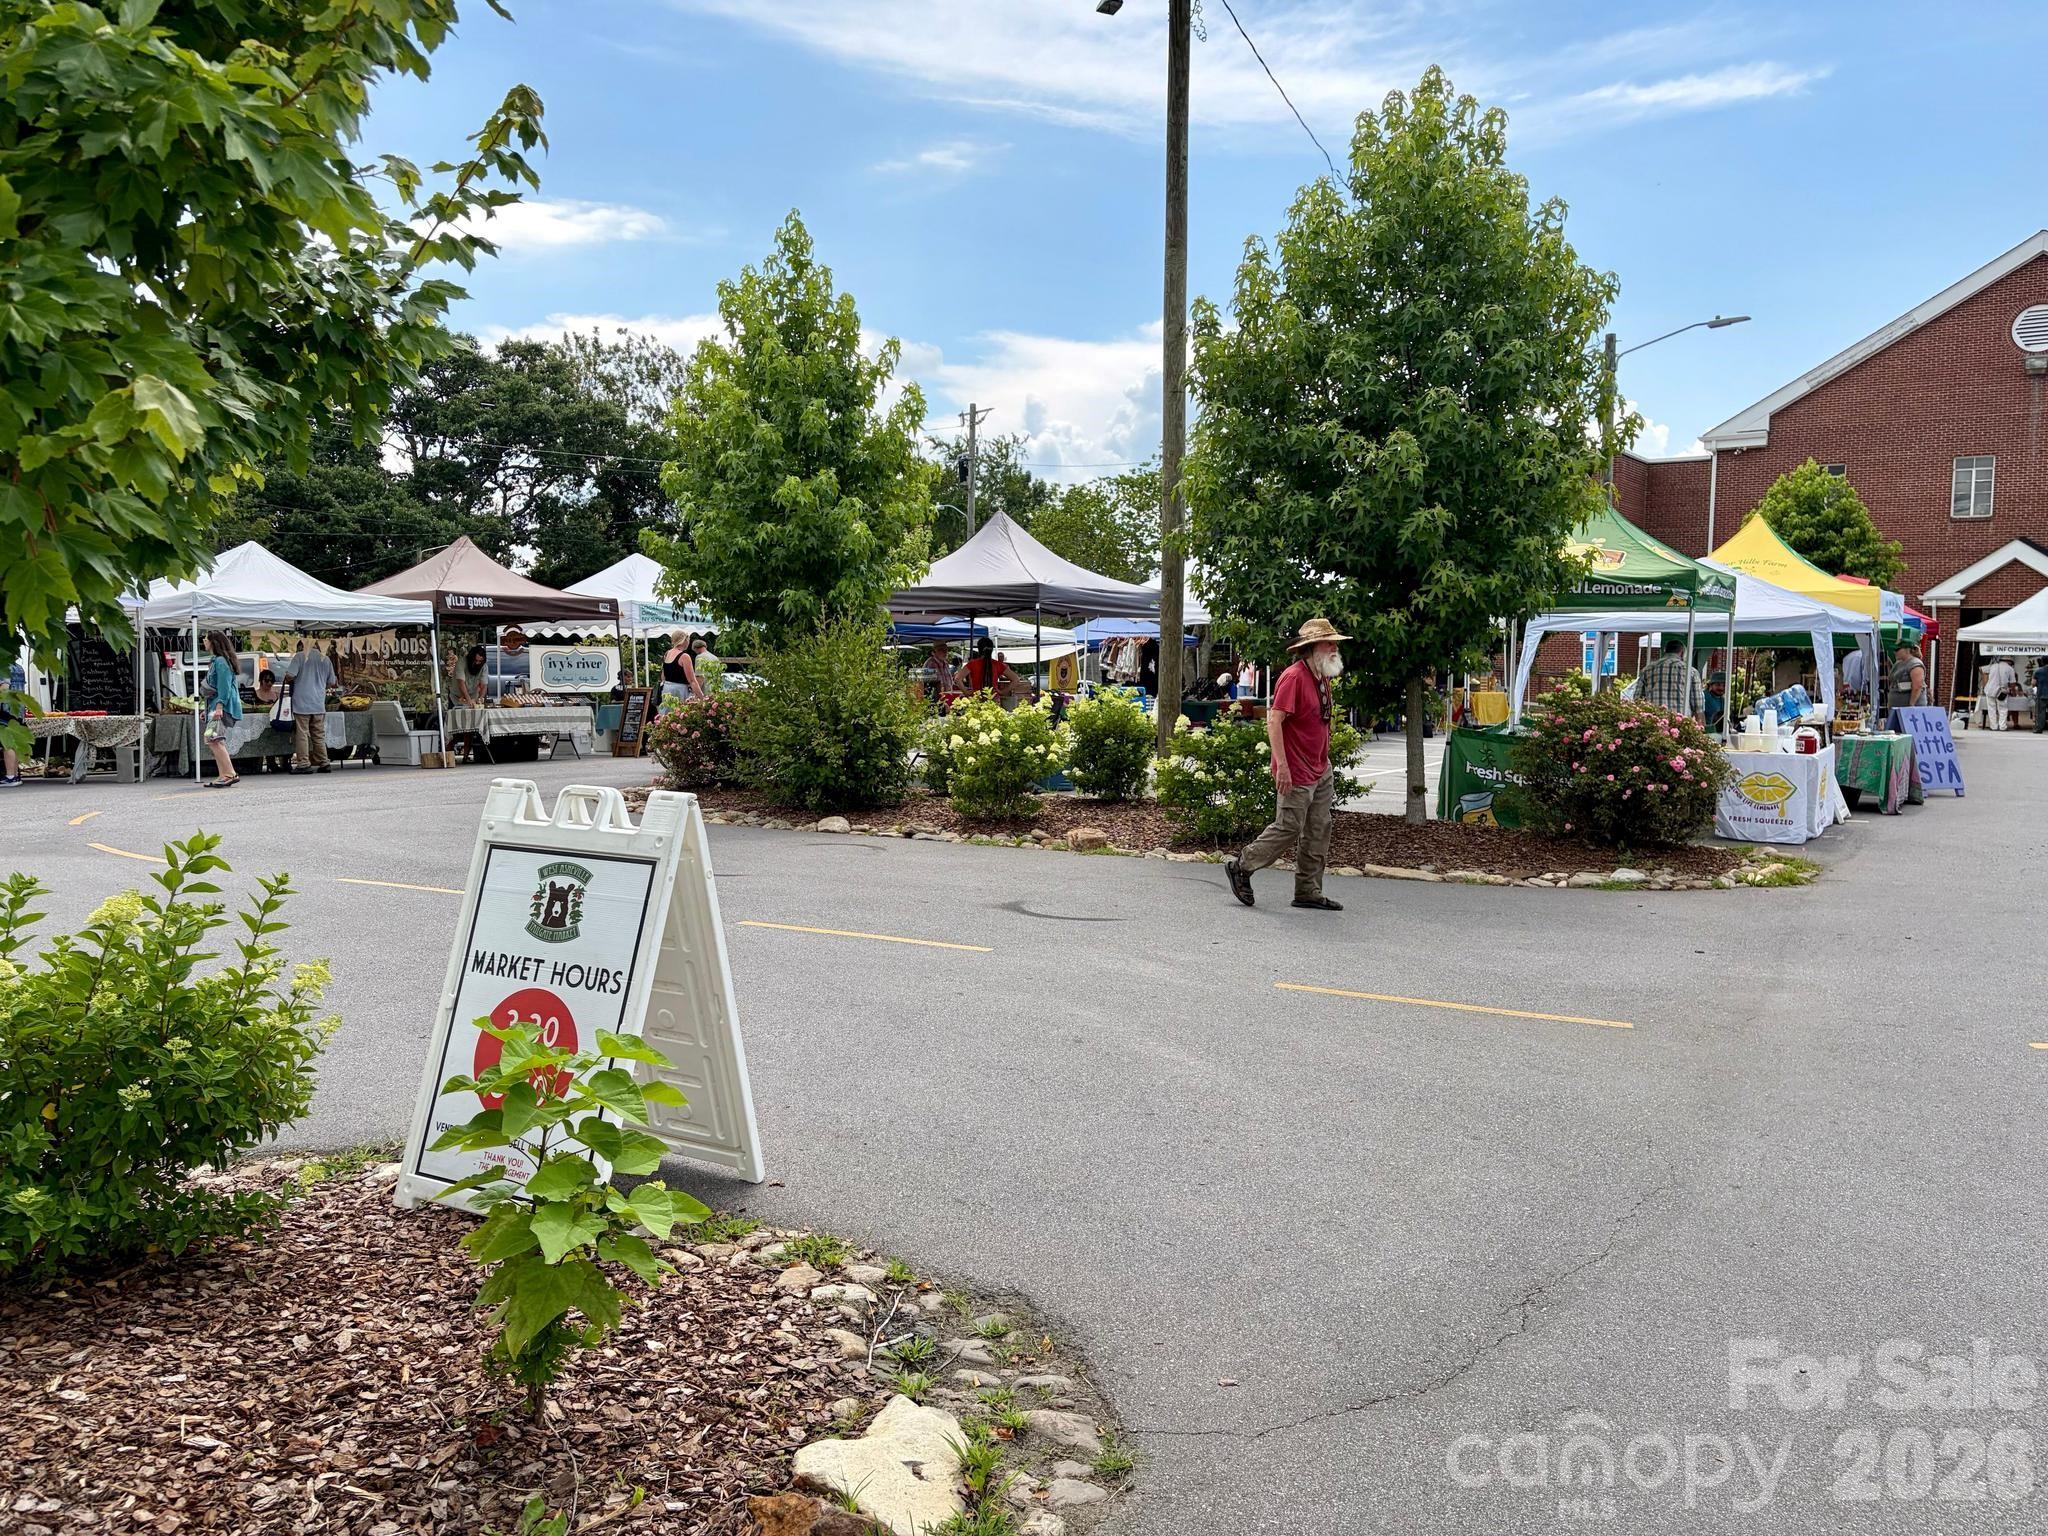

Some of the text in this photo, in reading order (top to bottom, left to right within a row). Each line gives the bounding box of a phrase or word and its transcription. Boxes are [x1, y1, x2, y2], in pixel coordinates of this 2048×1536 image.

[1584, 581, 1662, 595] Lemonade
[1996, 645, 2047, 653] INFORMATION
[548, 656, 602, 672] ivy's river
[1909, 712, 1944, 733] the
[1912, 734, 1954, 756] little
[1465, 760, 1501, 781] Fresh
[1918, 758, 1961, 784] SPA
[1728, 815, 1794, 826] FRESH SQUEEZED
[543, 864, 558, 877] WEST
[471, 949, 624, 995] MARKET HOURS
[478, 1161, 490, 1171] THE
[483, 1151, 524, 1168] THANK YOU!
